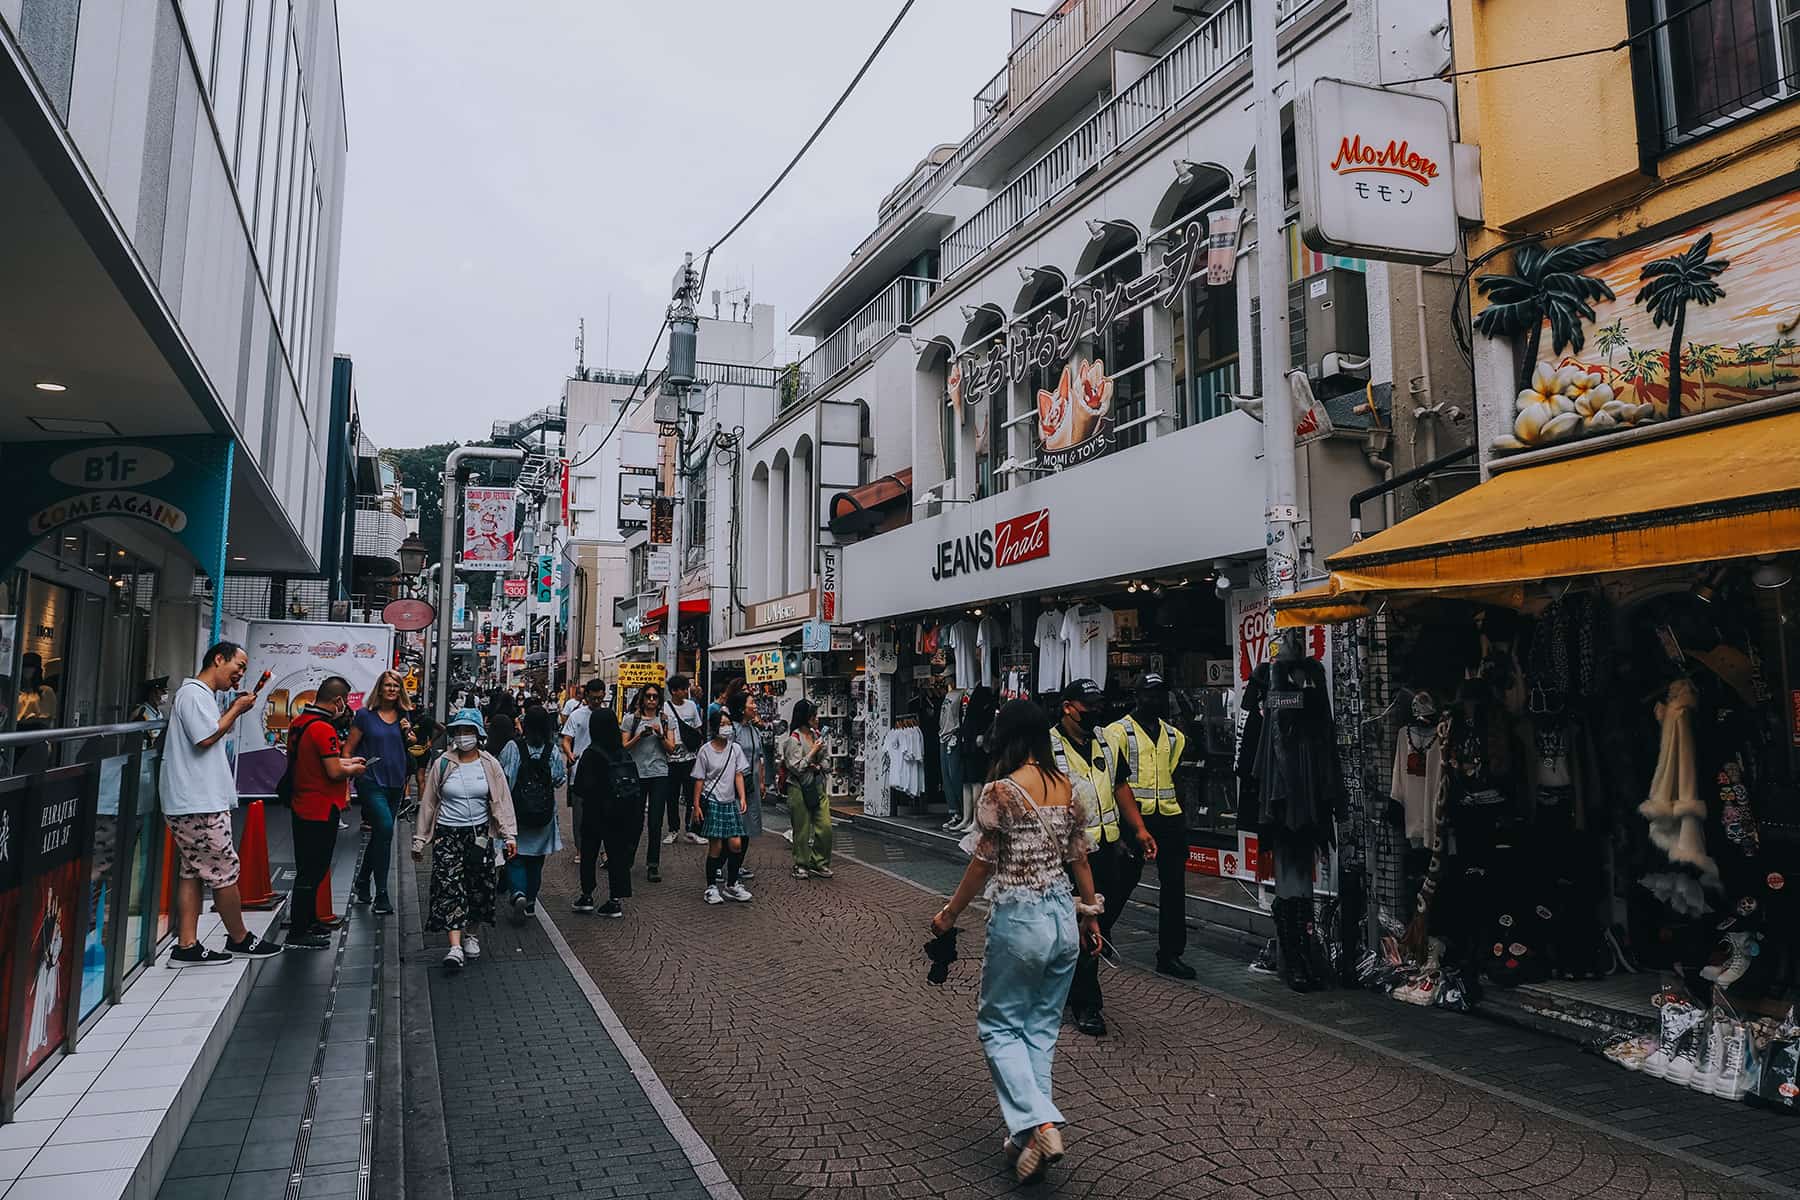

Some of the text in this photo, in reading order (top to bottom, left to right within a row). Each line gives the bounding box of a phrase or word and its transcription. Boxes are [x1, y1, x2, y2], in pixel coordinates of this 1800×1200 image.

[1355, 182, 1413, 204] モモン
[84, 450, 138, 482] B1F
[1043, 434, 1105, 466] MOMI & TOY'S
[37, 494, 180, 530] COME AGAIN
[932, 509, 1049, 581] JEANS mate
[825, 551, 835, 591] JEANS
[1190, 851, 1206, 863] FREE
